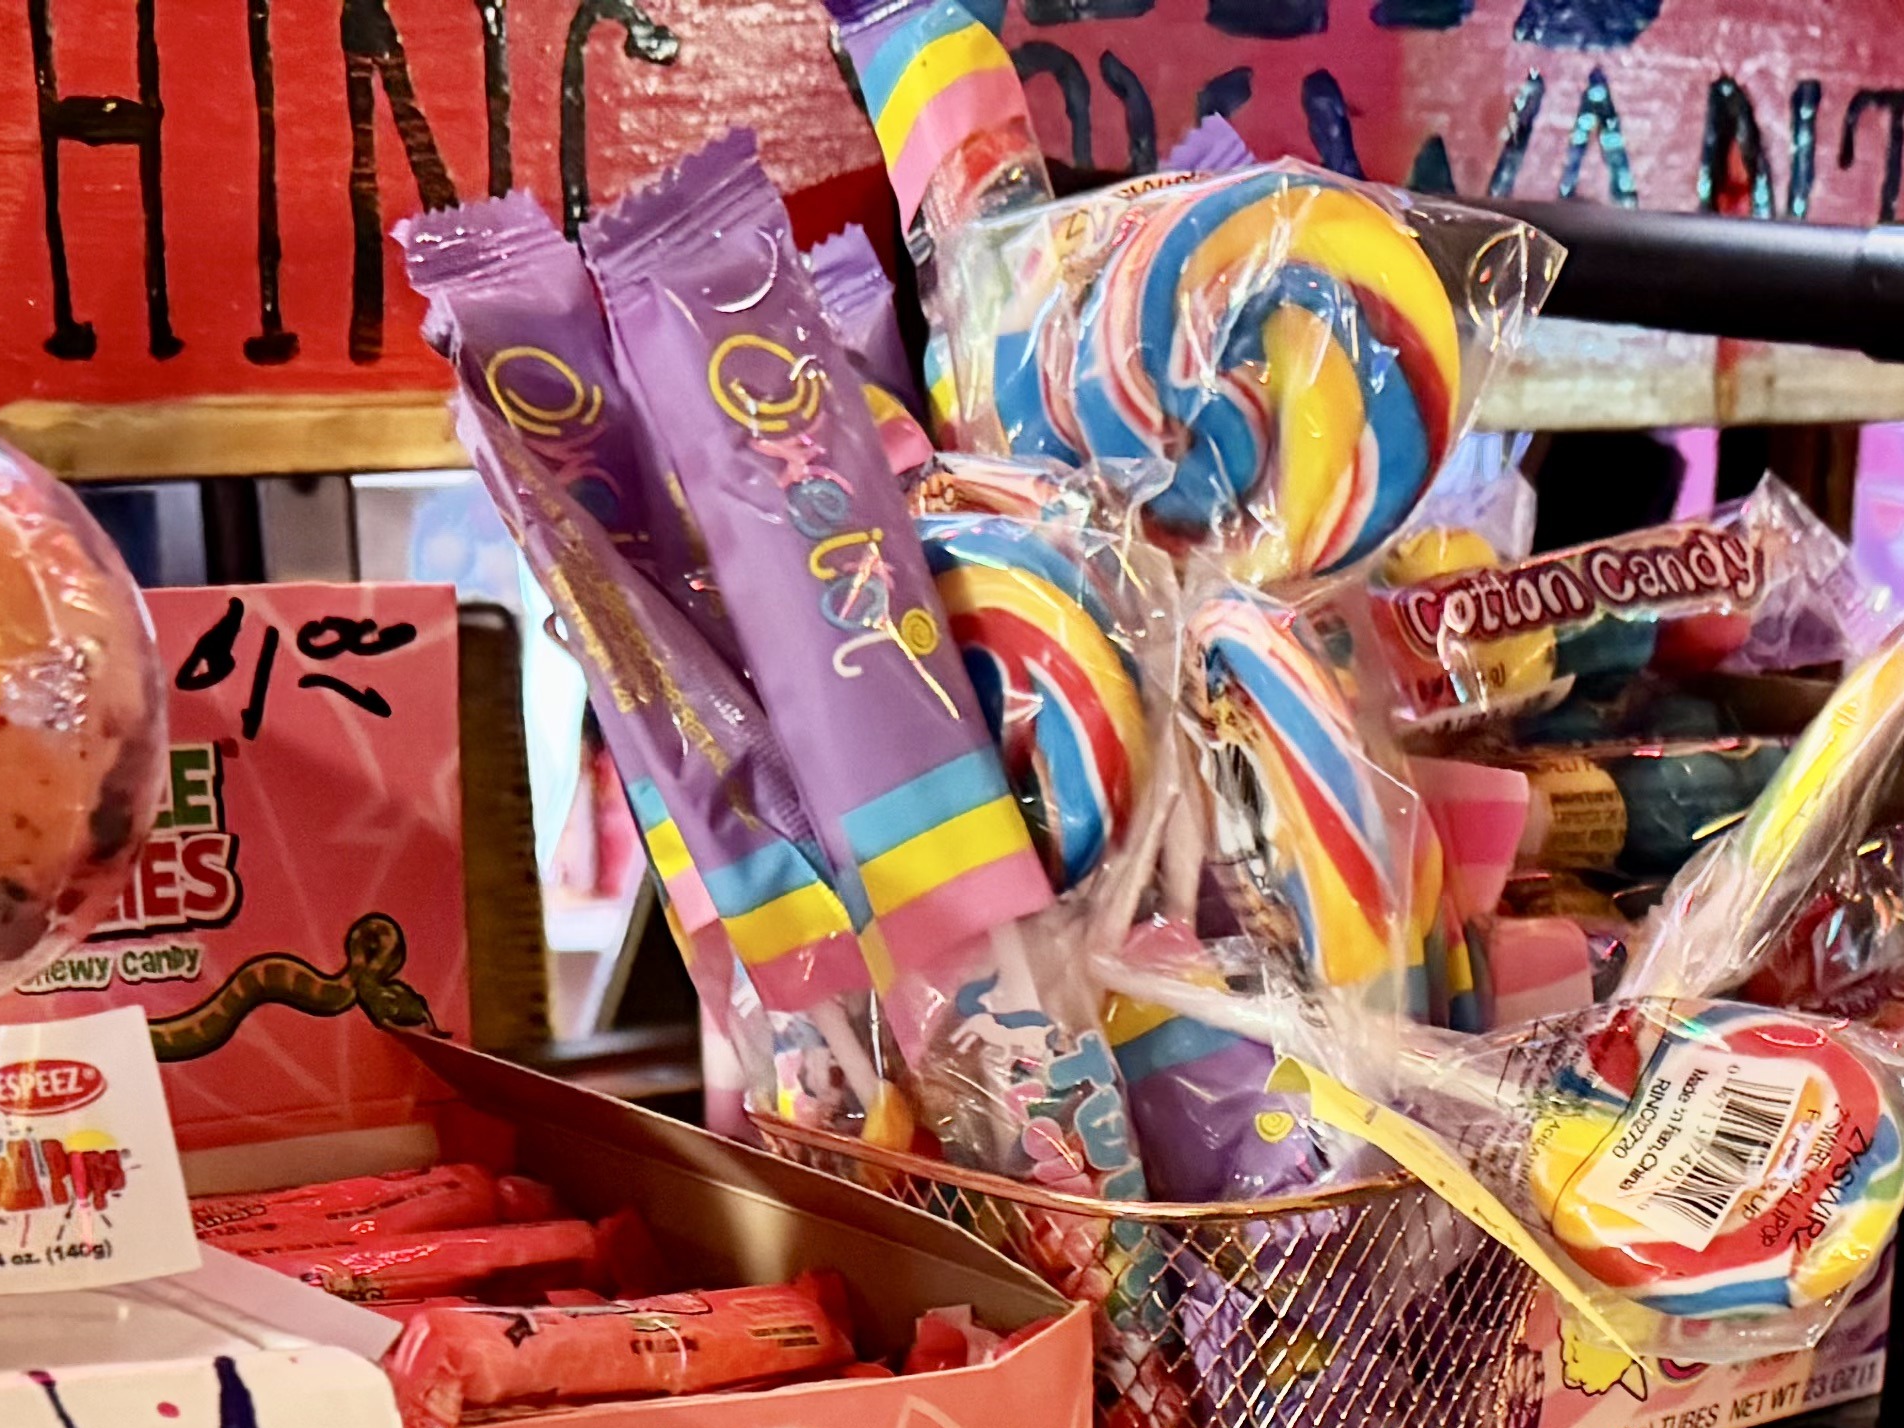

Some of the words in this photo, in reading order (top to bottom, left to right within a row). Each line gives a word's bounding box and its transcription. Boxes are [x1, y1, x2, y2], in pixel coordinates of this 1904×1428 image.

[1404, 550, 1587, 646] Cotton
[1591, 523, 1762, 612] Candy
[30, 947, 111, 991] hewy
[1728, 1390, 1765, 1422] NET
